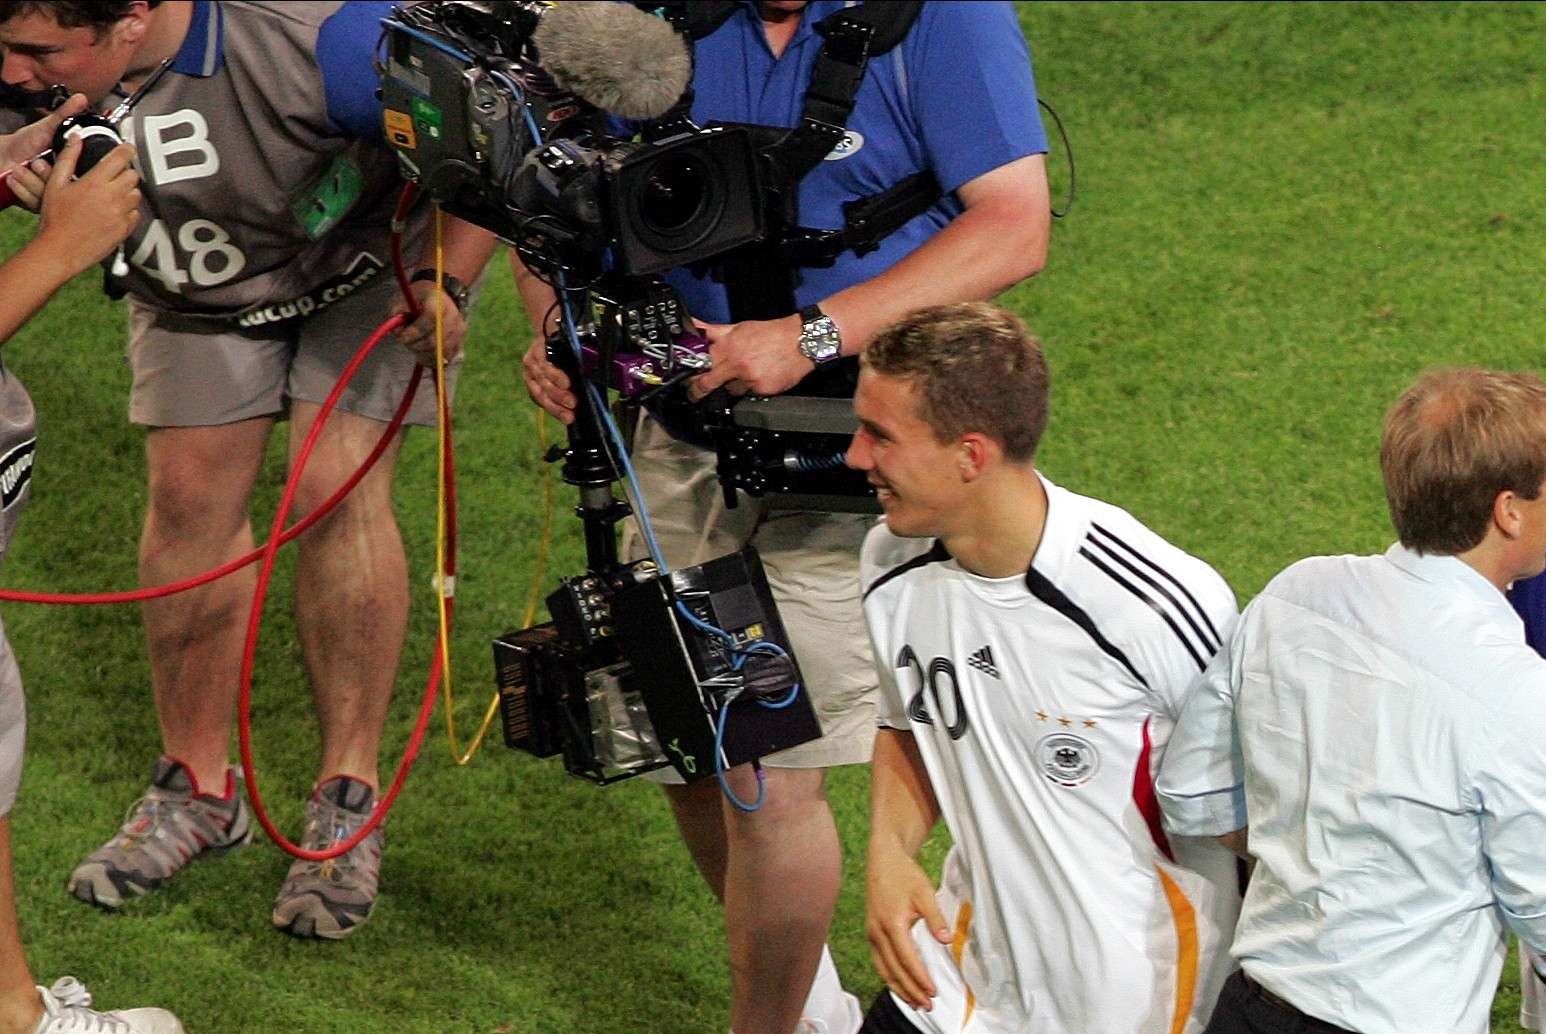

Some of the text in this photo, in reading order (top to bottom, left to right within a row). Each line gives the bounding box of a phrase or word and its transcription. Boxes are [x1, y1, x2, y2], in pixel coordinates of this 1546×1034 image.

[119, 108, 220, 186] B
[130, 218, 247, 294] 48
[896, 644, 968, 741] 20
